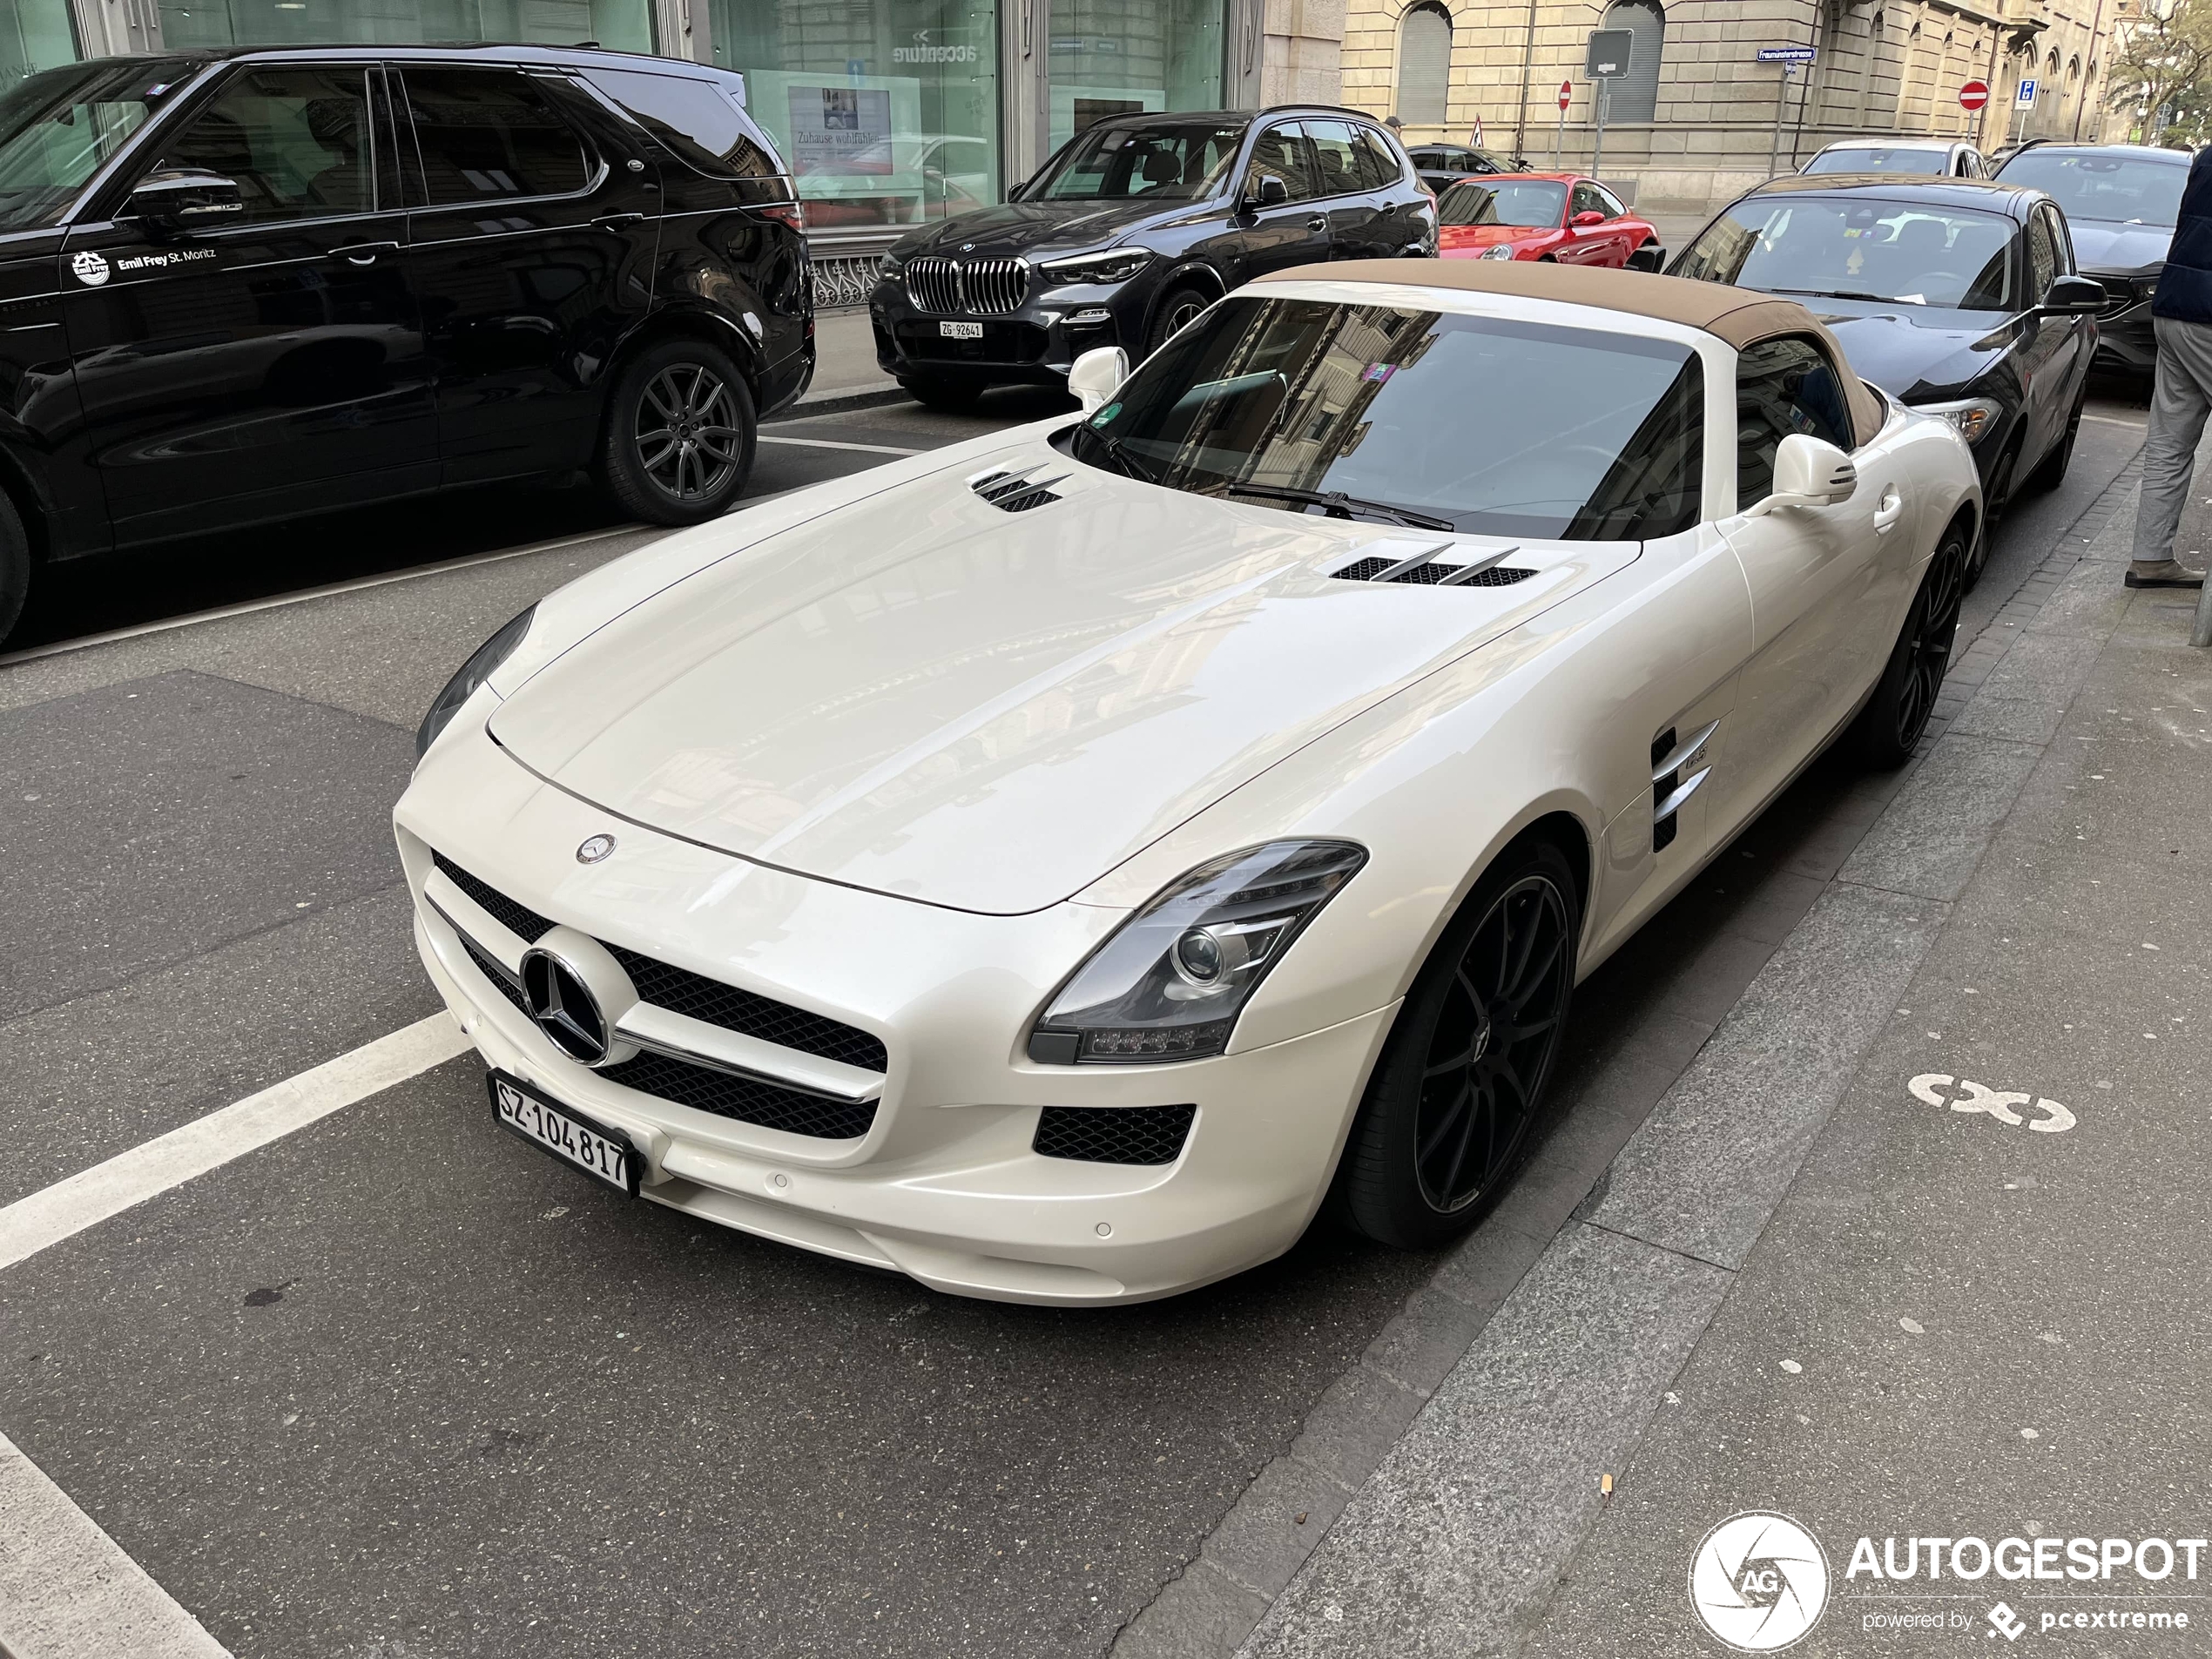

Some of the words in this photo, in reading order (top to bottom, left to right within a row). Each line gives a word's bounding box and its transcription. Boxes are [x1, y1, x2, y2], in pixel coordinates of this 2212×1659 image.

[798, 131, 833, 144] Zuhause
[836, 132, 880, 145] wohlfühlen
[117, 256, 144, 271] Emil
[144, 254, 167, 267] Frey
[167, 253, 183, 263] St.
[183, 248, 217, 262] Moritz
[73, 265, 92, 275] Emil
